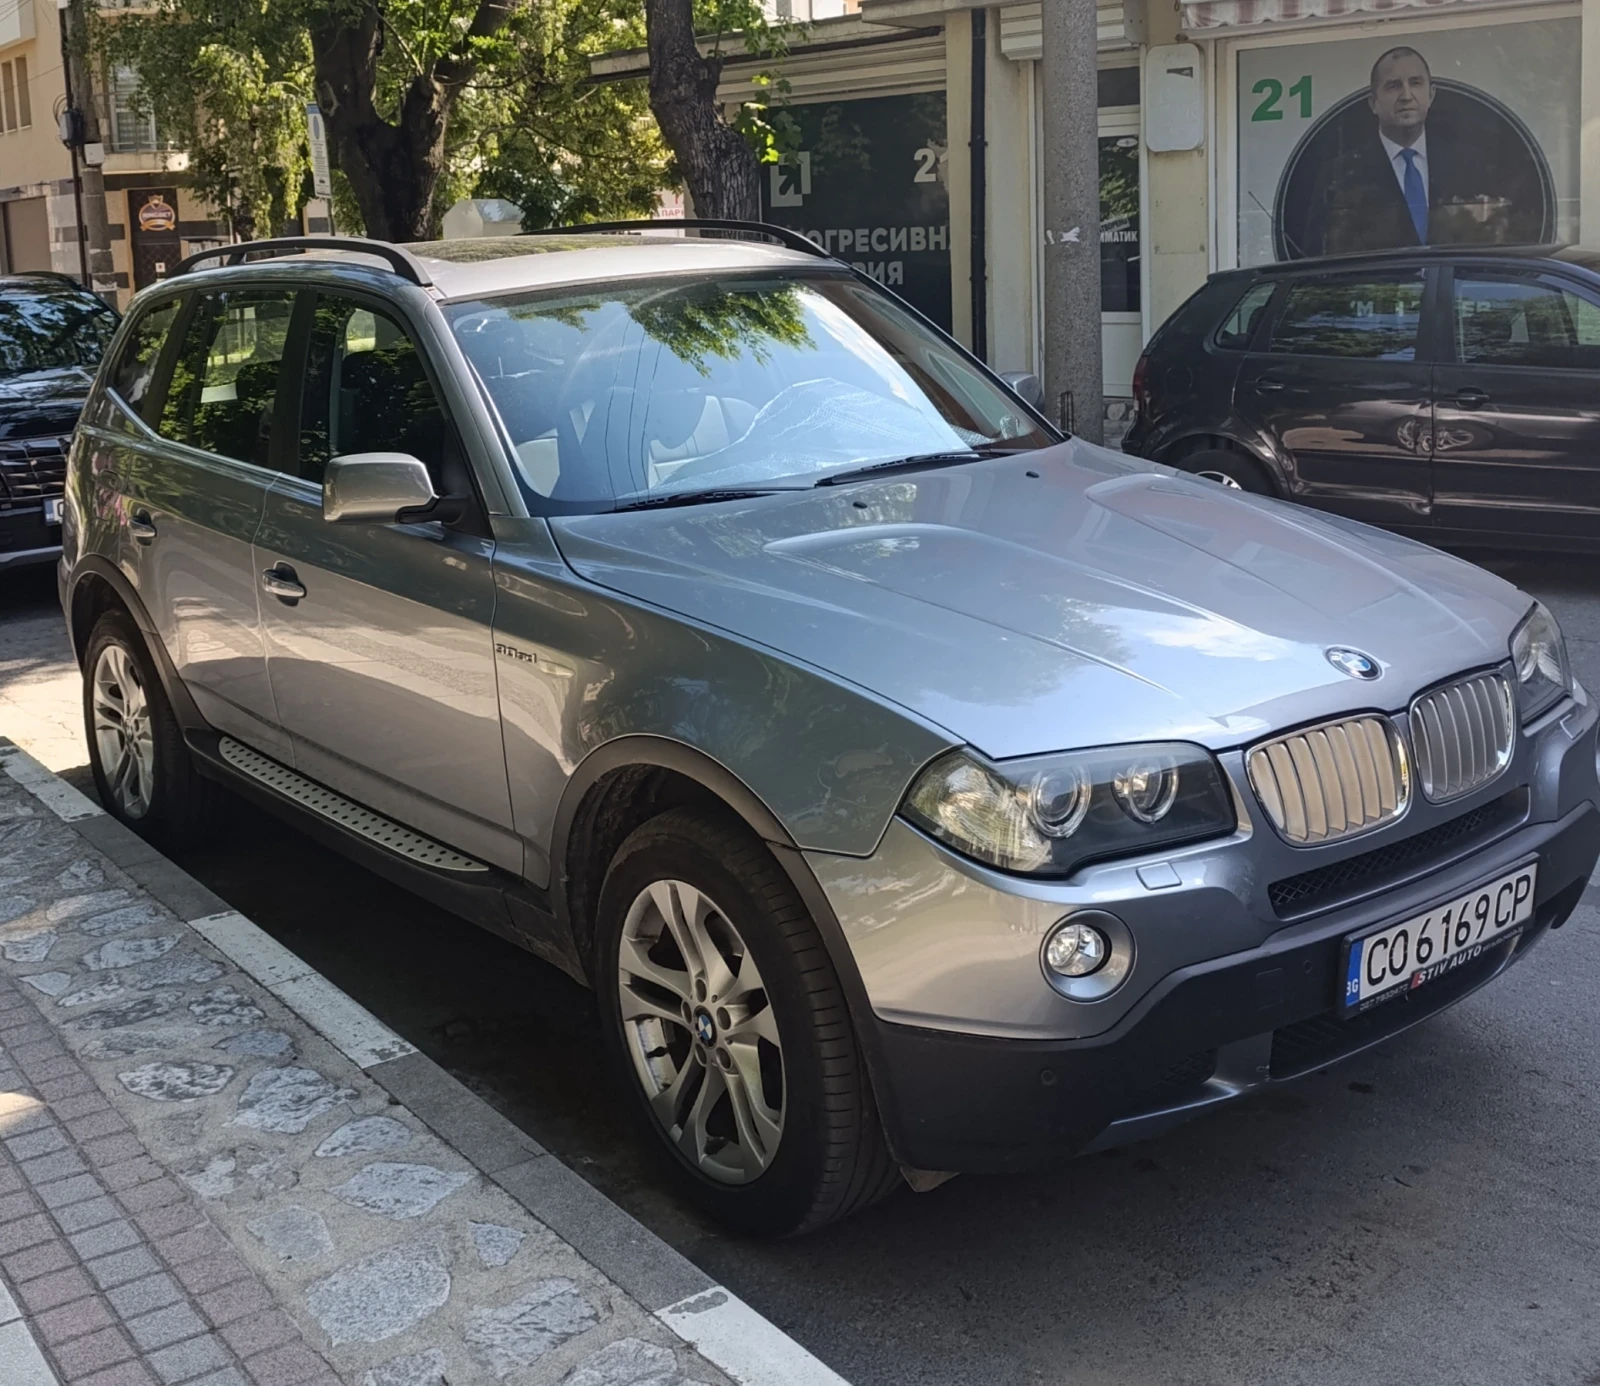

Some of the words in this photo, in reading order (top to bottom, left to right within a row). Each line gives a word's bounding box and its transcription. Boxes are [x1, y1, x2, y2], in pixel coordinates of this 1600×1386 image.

[1251, 75, 1313, 122] 21
[795, 225, 950, 253] ОГРЕСИВН
[1416, 894, 1490, 964] 6169
[1418, 961, 1448, 984] STIV
[1449, 945, 1482, 970] AUTO
